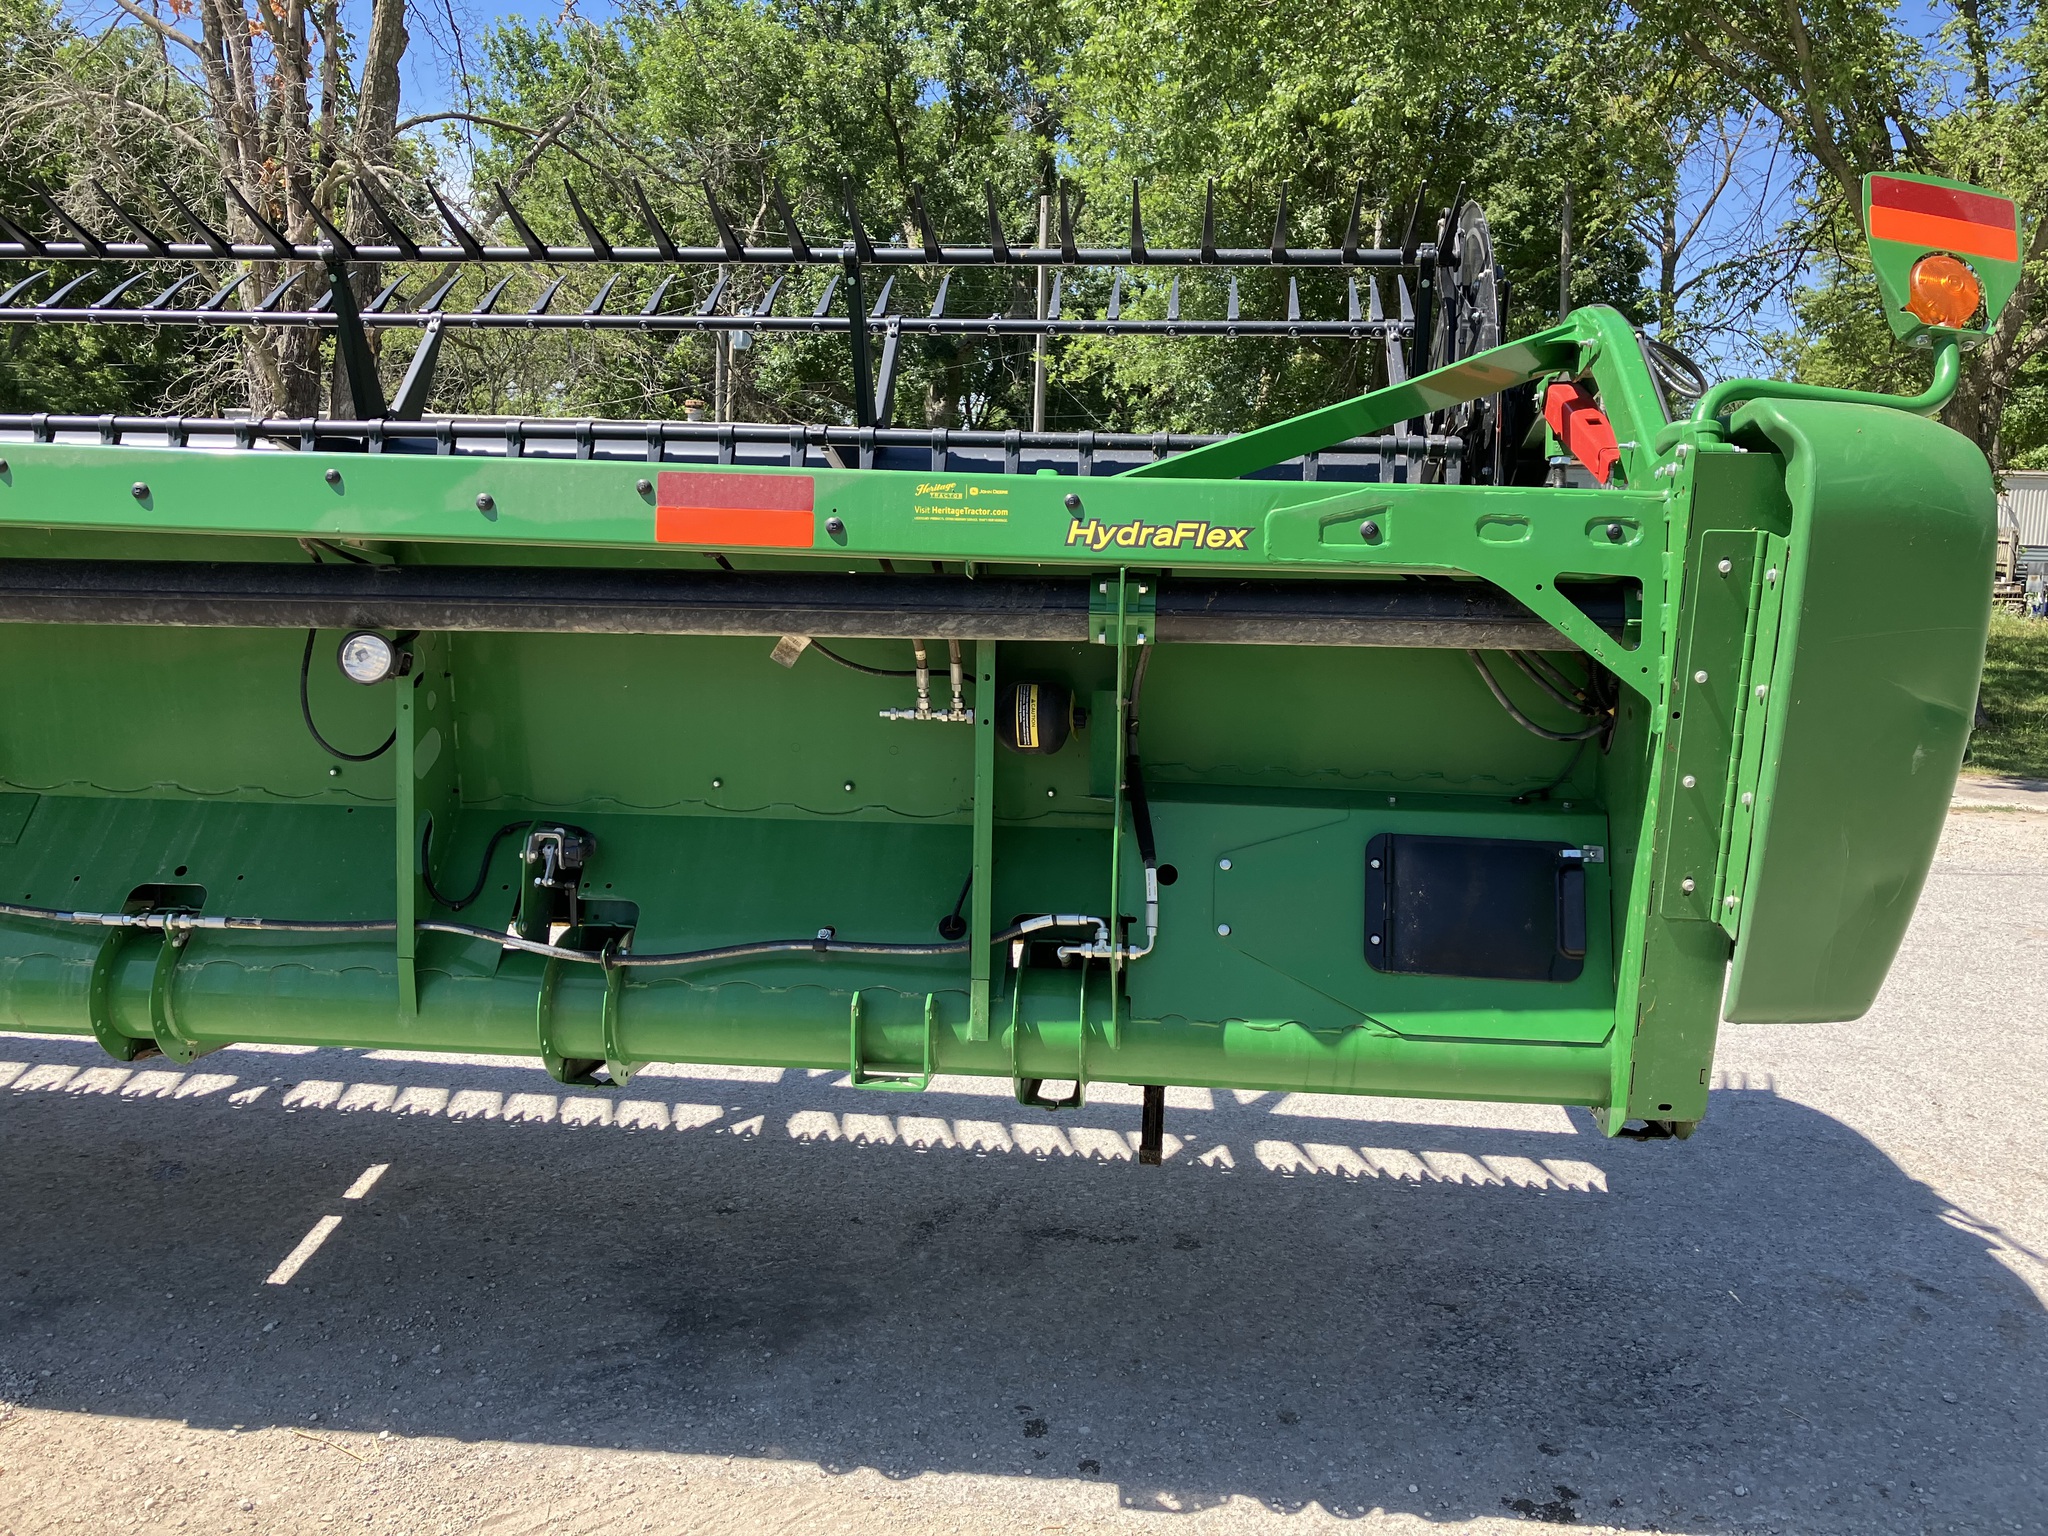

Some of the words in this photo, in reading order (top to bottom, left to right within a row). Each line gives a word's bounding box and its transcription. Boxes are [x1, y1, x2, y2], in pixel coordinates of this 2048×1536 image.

[915, 483, 957, 496] Heritage
[914, 505, 930, 514] Visit
[931, 506, 1009, 517] HeritageTractor.com
[1064, 518, 1255, 552] HydraFlex
